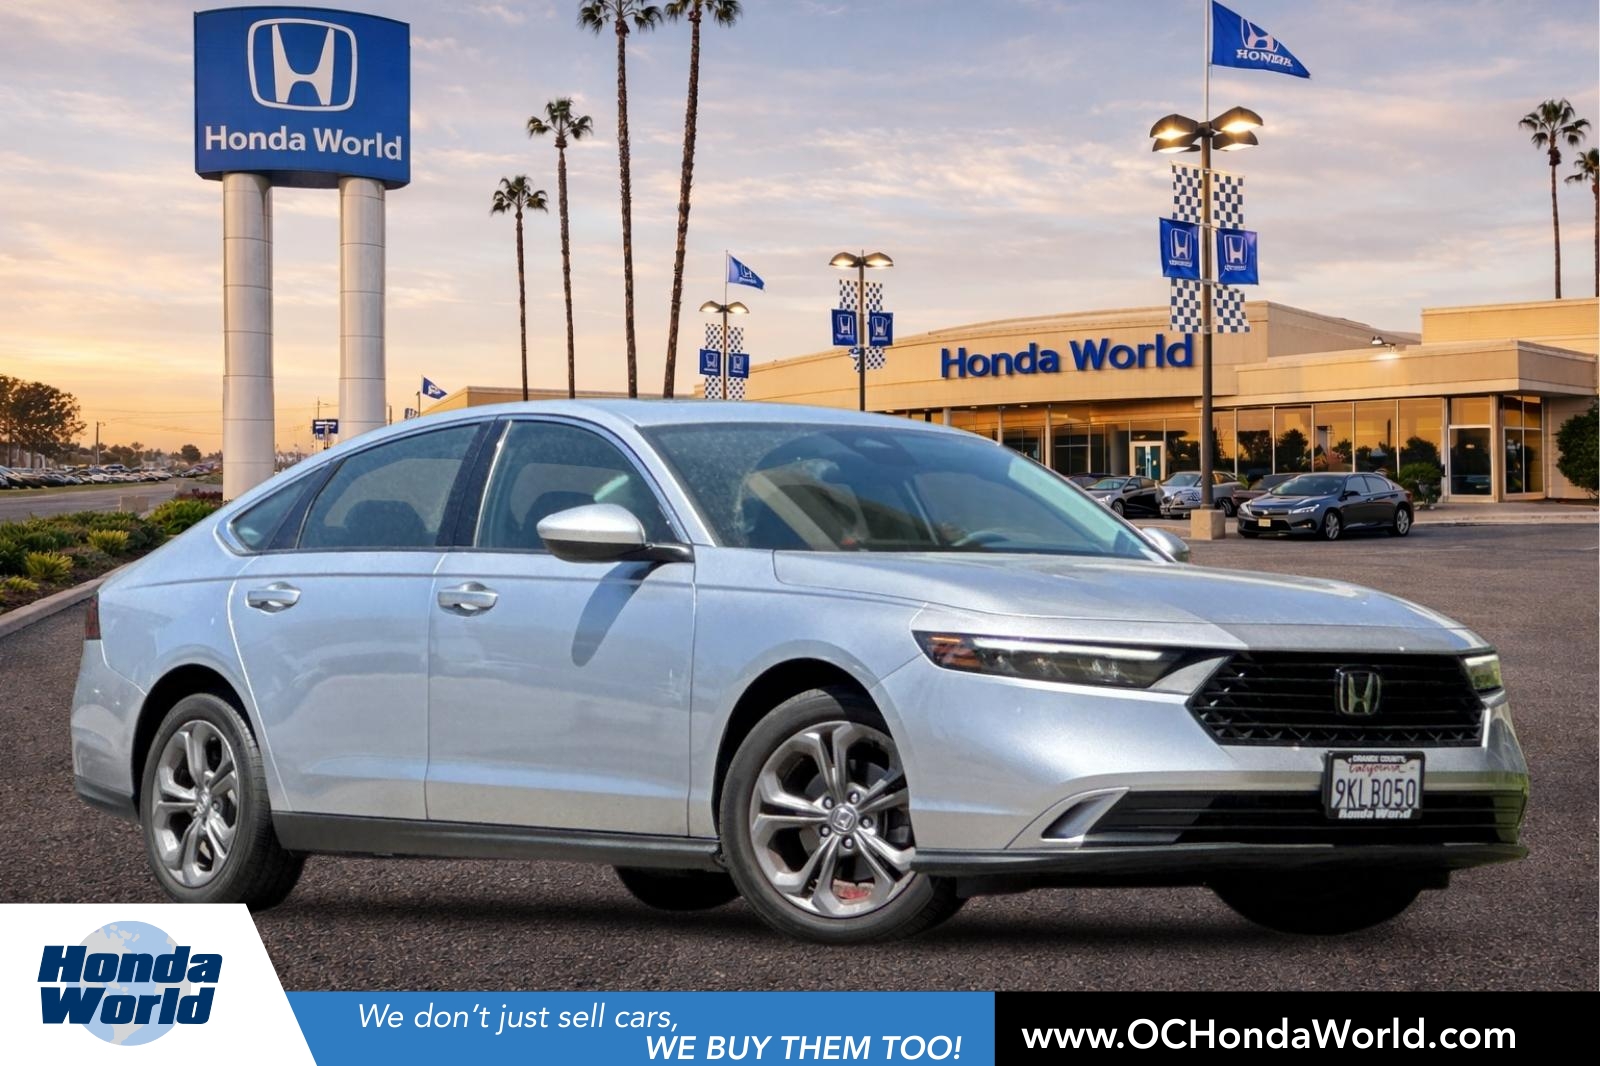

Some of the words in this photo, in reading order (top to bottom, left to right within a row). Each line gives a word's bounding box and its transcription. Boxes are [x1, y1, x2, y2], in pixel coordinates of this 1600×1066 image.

[205, 125, 306, 151] Honda
[313, 127, 402, 161] World
[941, 342, 1060, 379] Honda
[1069, 333, 1194, 372] World
[1334, 778, 1416, 809] 9KLB050
